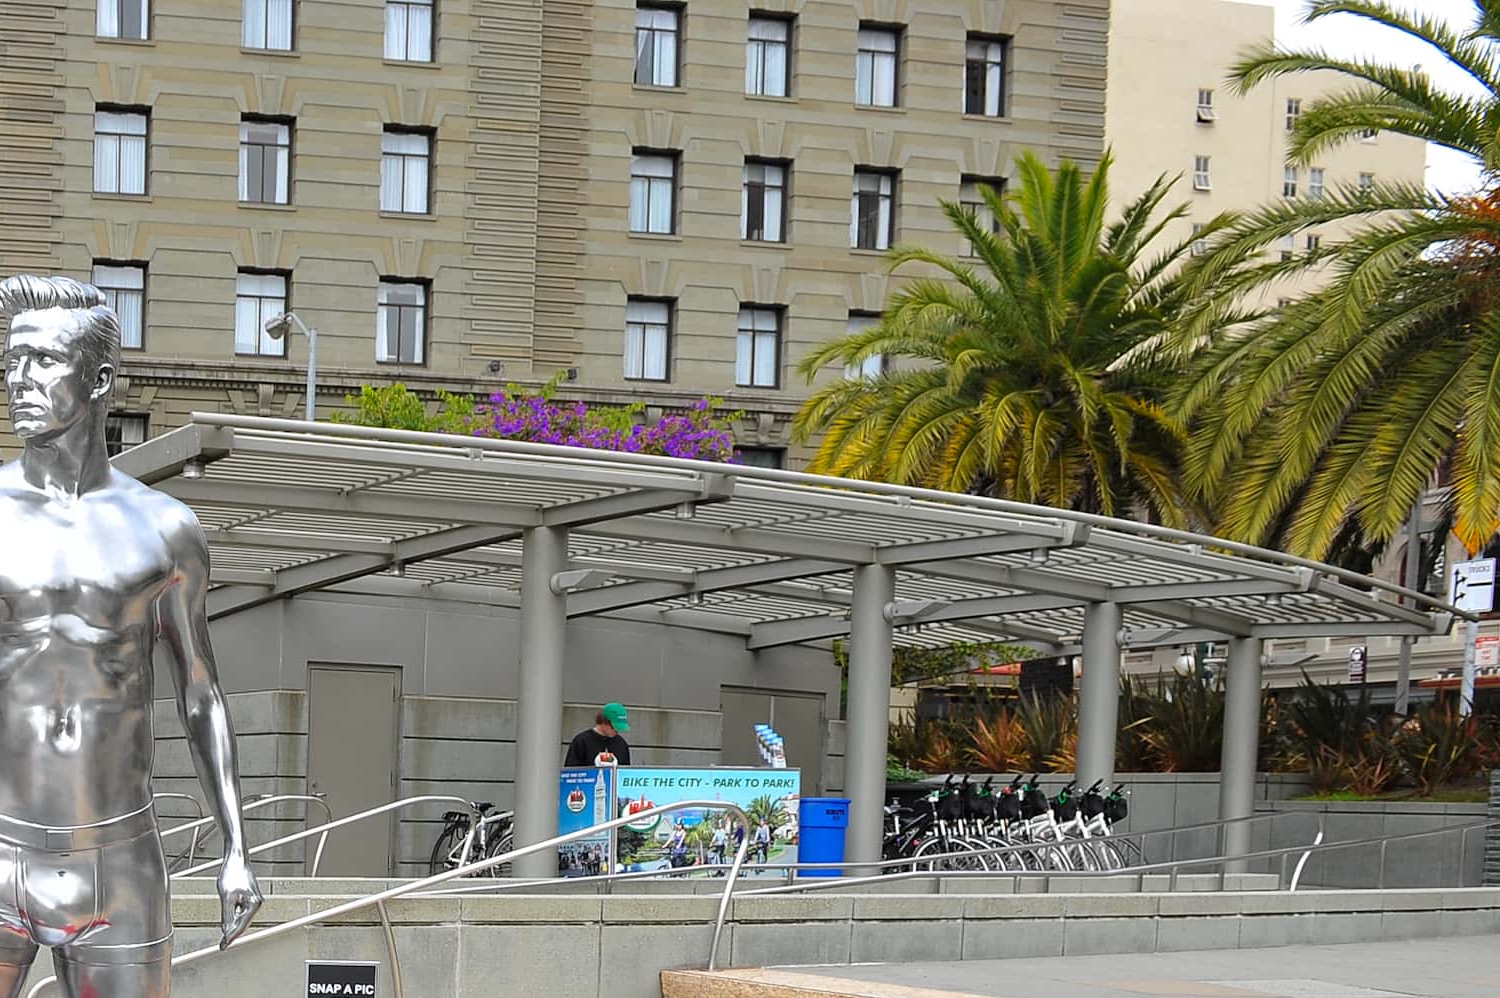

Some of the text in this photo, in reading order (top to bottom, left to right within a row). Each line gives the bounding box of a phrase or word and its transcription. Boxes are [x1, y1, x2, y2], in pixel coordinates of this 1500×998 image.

[622, 777, 649, 787] BIKE
[652, 777, 675, 787] THE
[678, 777, 702, 787] CITY
[713, 778, 742, 788] PARK
[744, 778, 759, 788] TO
[762, 778, 795, 789] PARK!
[309, 983, 375, 996] SNAP A PIC
